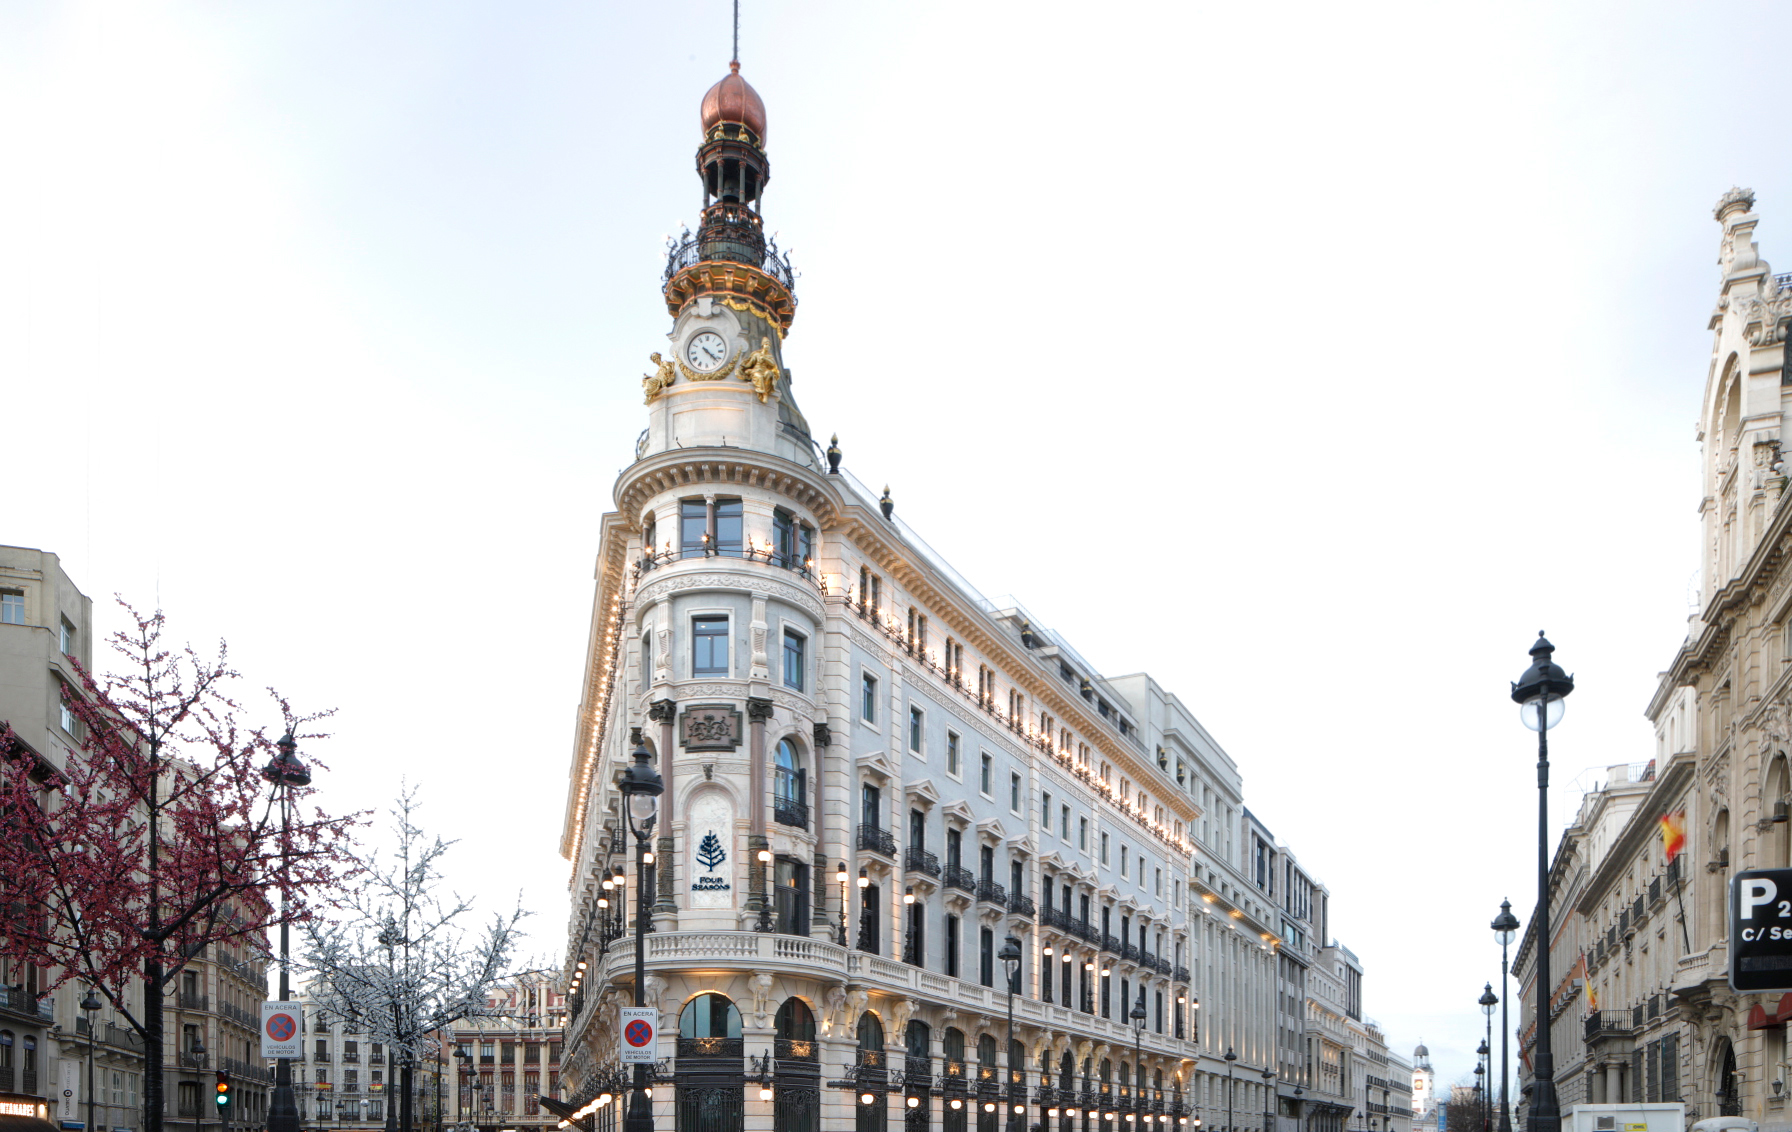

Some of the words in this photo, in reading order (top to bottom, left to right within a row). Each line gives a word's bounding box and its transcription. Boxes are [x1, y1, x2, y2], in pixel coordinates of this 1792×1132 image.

[699, 876, 723, 884] FOUR
[691, 883, 731, 891] SEASONS
[1740, 878, 1778, 920] P
[1778, 900, 1791, 918] 2
[1741, 927, 1765, 941] C/
